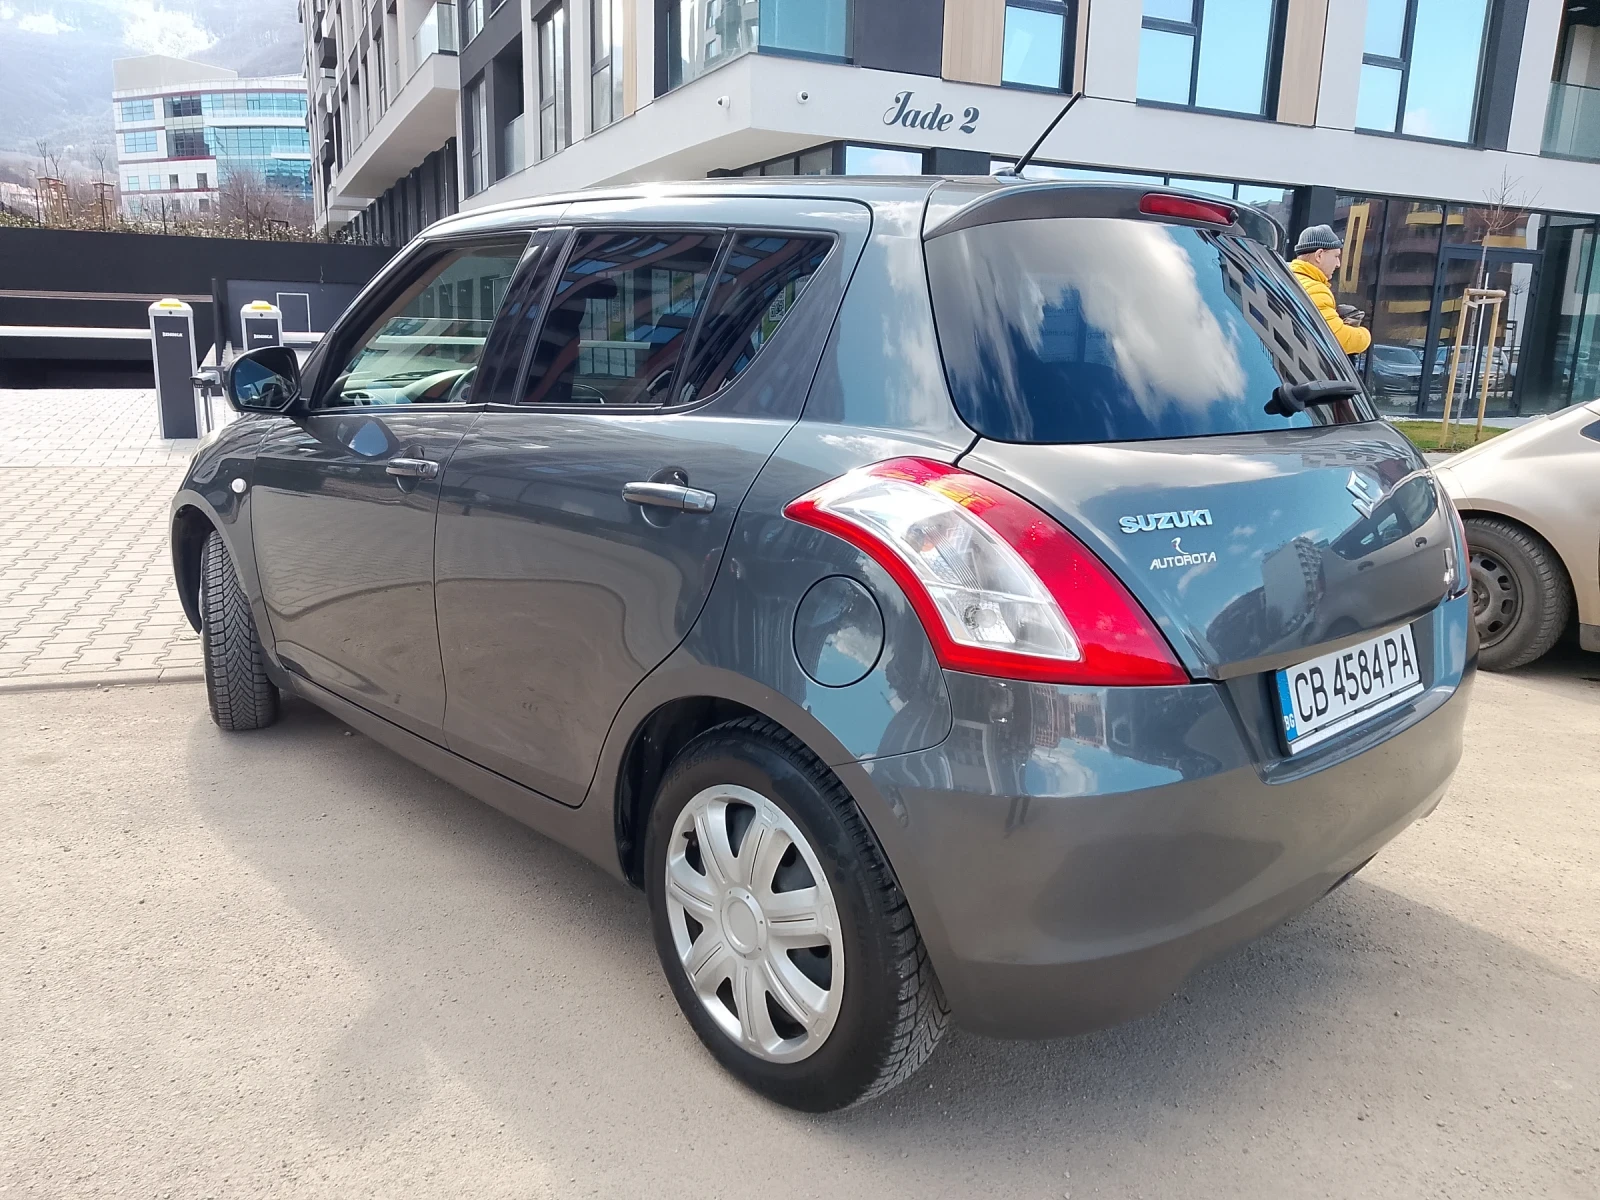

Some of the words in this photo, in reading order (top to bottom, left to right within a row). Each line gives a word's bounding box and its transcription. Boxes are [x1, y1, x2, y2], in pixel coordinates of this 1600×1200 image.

[883, 91, 954, 132] Jade
[959, 106, 980, 134] 2
[1119, 509, 1213, 534] SUZUKI
[1149, 551, 1217, 570] AUTOROTA
[1294, 666, 1329, 723] CB
[1333, 643, 1385, 705] 4584
[1383, 633, 1415, 685] PA
[1283, 715, 1295, 731] BG
